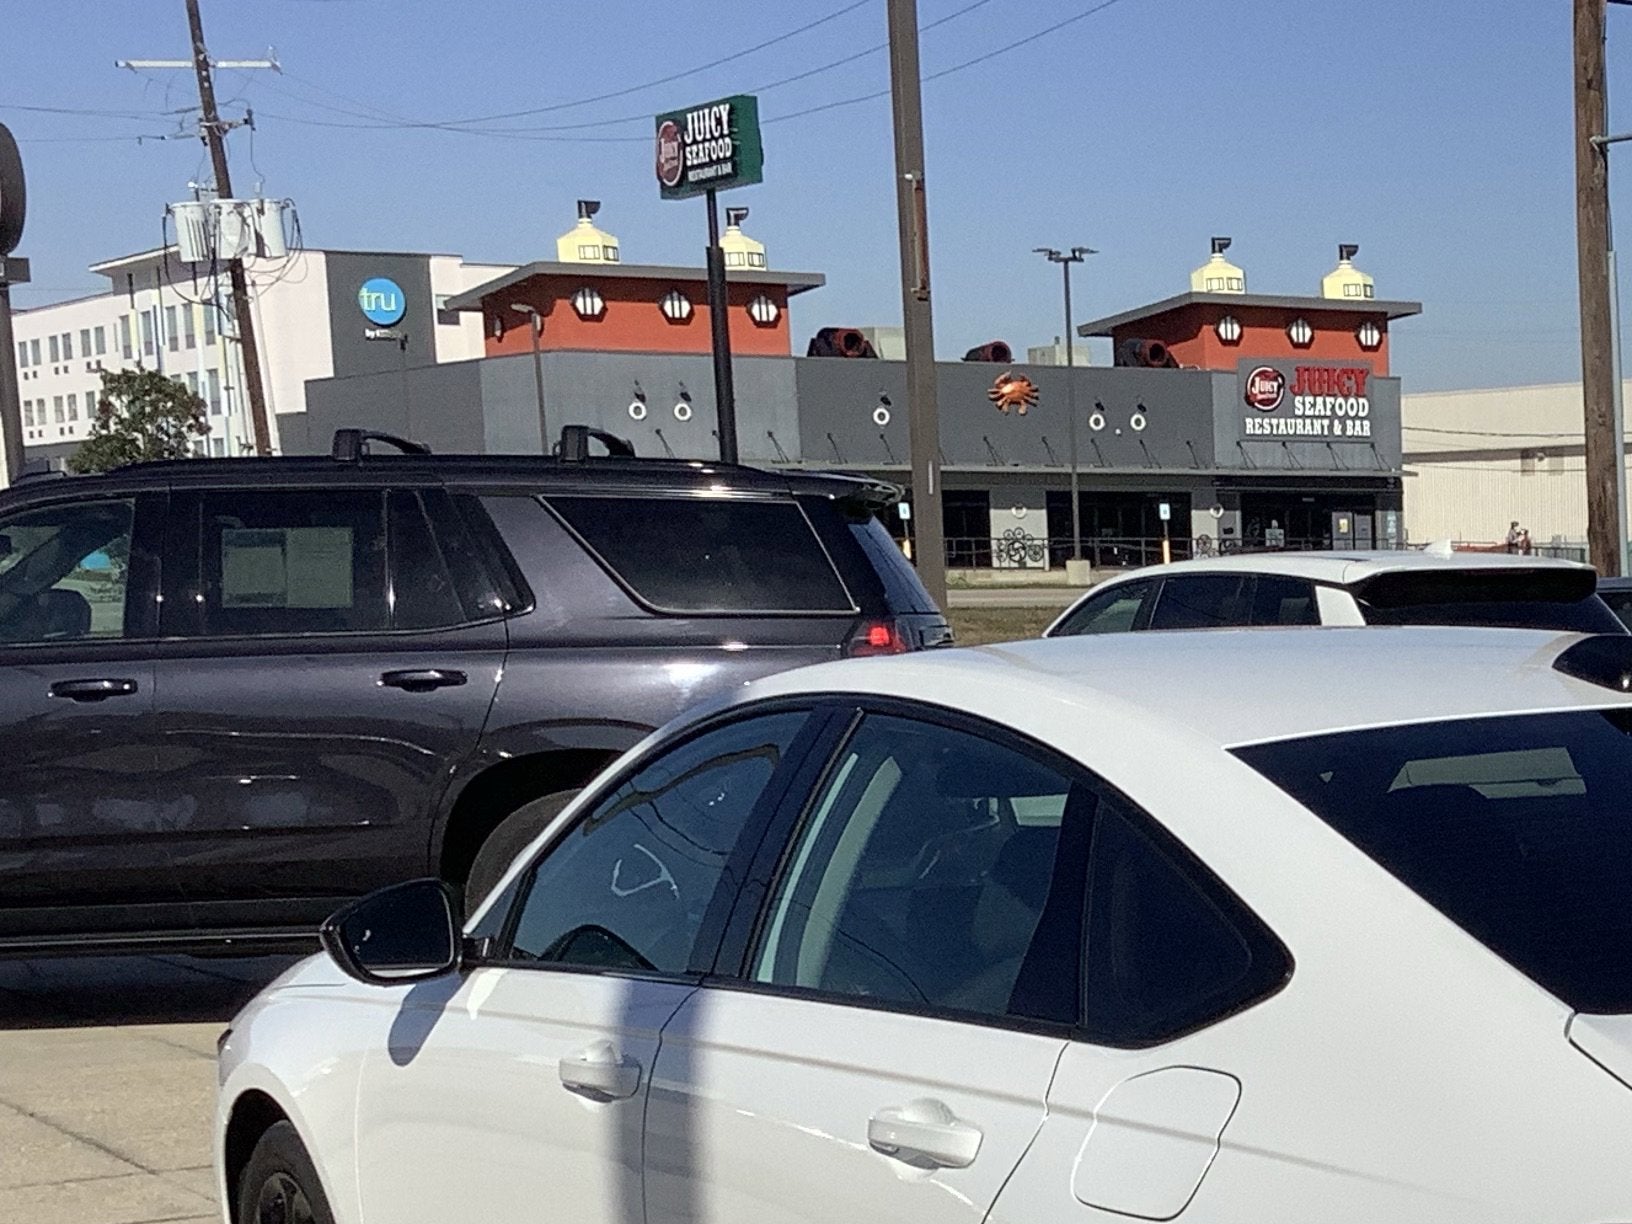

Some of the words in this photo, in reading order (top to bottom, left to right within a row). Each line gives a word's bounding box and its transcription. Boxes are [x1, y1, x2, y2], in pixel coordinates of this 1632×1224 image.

[683, 103, 730, 145] JUICY
[685, 136, 732, 167] SEAFOOD
[360, 287, 396, 311] tru
[1290, 366, 1370, 397] JUICY
[1295, 396, 1369, 417] SEAFOOD
[1245, 418, 1329, 436] RESTAURANT
[1333, 420, 1342, 436] &
[1346, 420, 1371, 437] BAR
